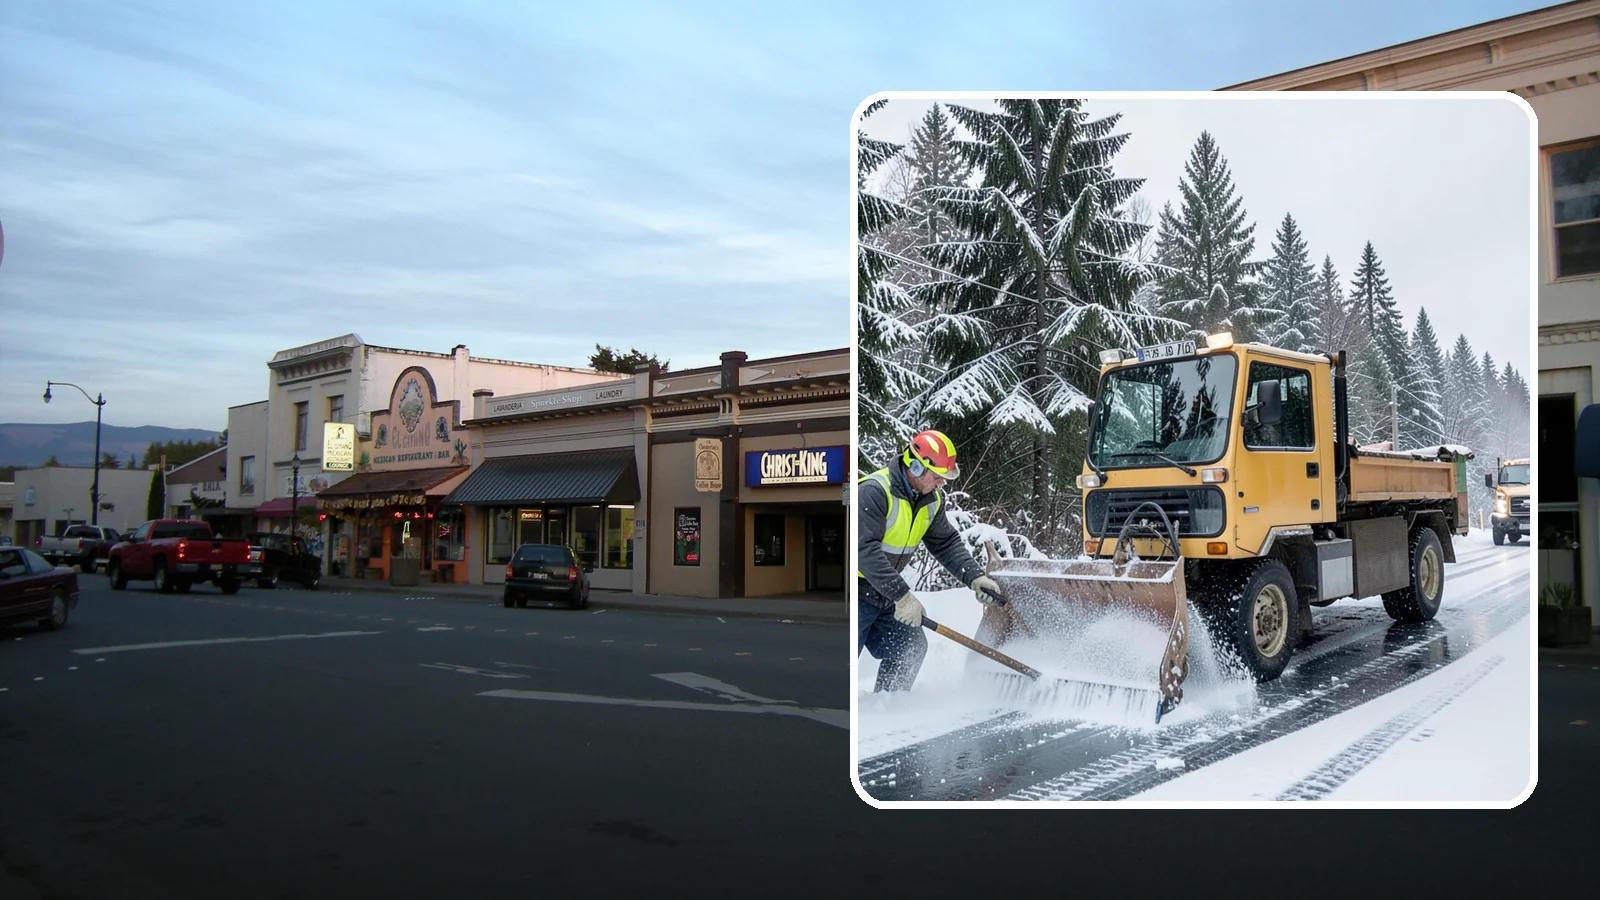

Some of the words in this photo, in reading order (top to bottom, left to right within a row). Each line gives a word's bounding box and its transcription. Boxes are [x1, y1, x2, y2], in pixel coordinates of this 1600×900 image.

[530, 397, 560, 409] Sparkle
[561, 394, 582, 405] Shop
[595, 389, 623, 400] LAUNDRY
[493, 402, 523, 413] LAVANDERIA
[373, 454, 396, 464] MEXICAN
[397, 451, 433, 462] RESTAURANT
[438, 450, 450, 459] BAR
[799, 450, 828, 476] KING
